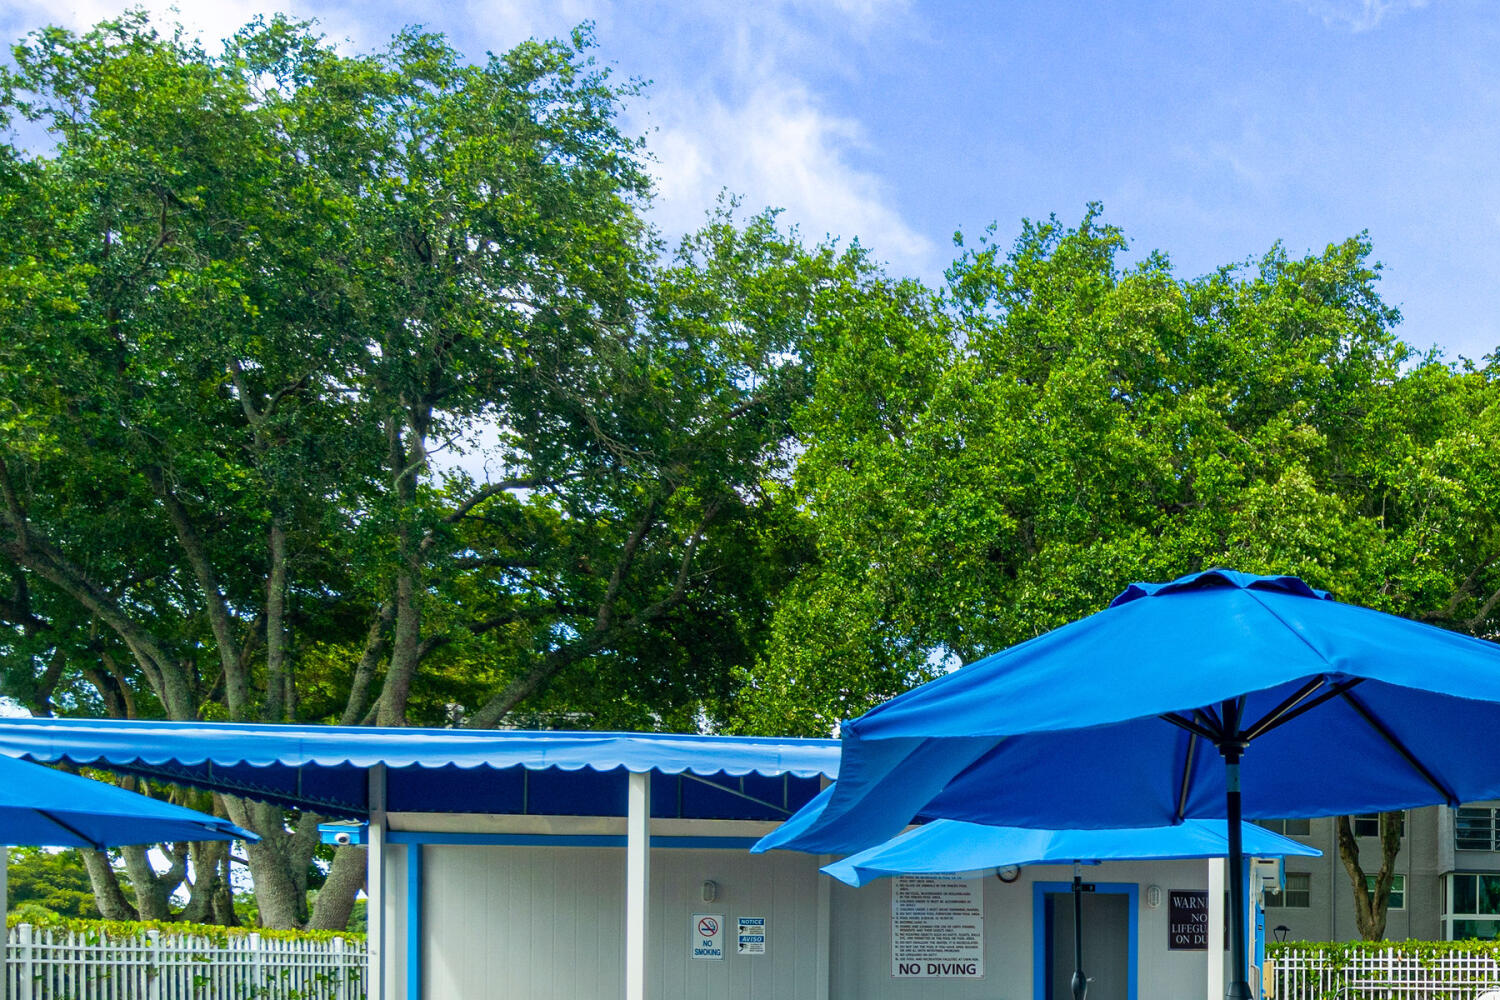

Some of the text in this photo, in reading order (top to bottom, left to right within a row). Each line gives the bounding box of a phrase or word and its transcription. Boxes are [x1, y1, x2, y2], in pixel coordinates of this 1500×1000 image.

[1191, 913, 1208, 922] NO
[1172, 924, 1207, 933] LIFEGU
[1176, 935, 1207, 944] ON DU
[899, 963, 977, 975] NO DIVING
